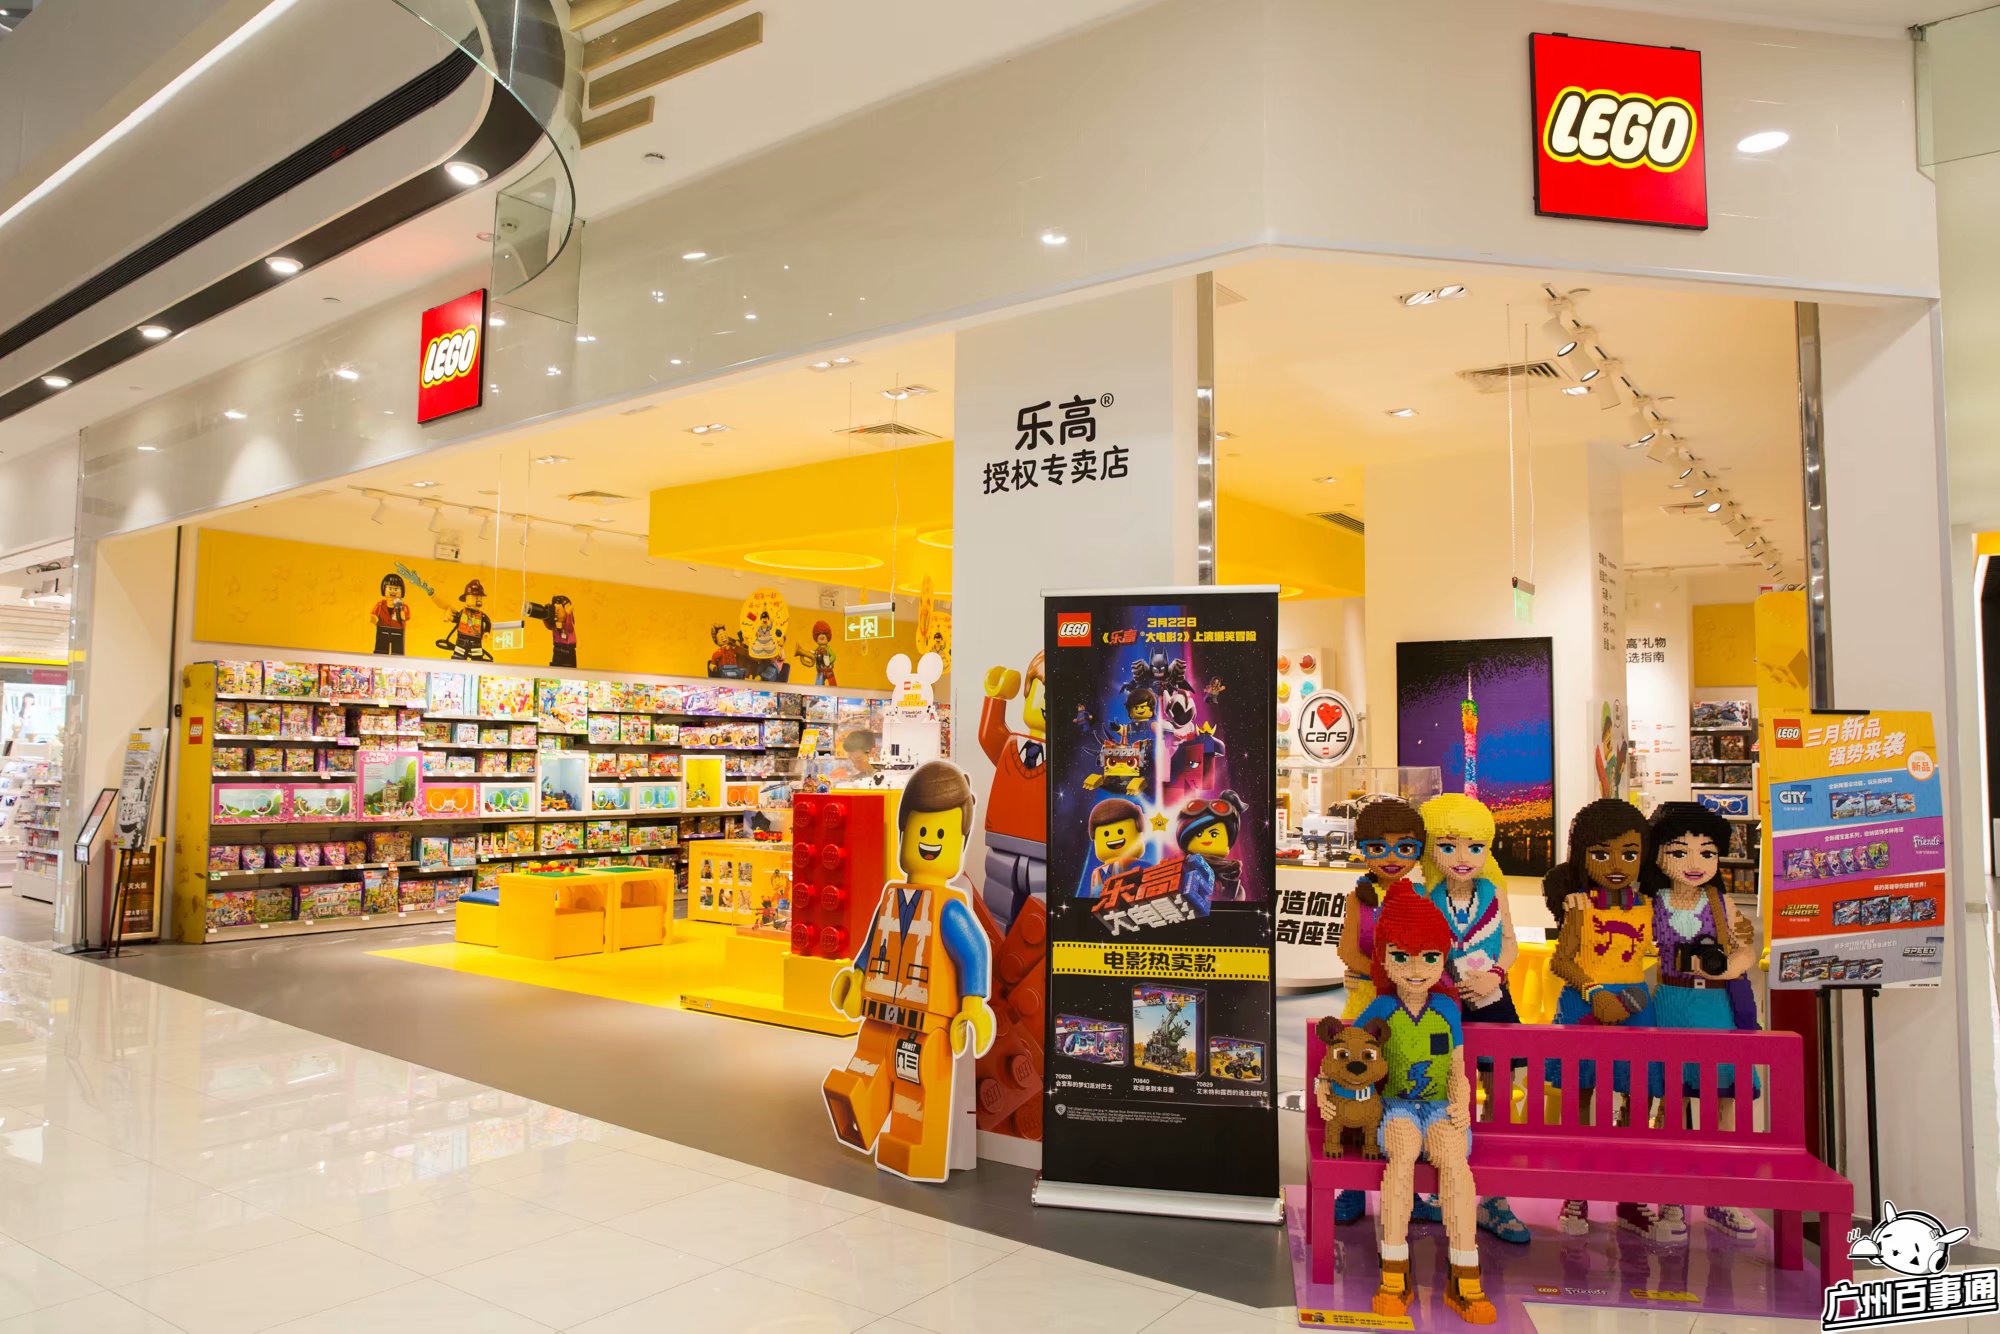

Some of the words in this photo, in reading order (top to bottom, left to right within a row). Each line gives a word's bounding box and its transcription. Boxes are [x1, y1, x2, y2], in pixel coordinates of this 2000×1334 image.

[1550, 92, 1692, 167] LEGO
[423, 328, 477, 385] LEGO
[983, 445, 1129, 494] 授权专卖店
[1059, 622, 1089, 637] LEGO
[1147, 617, 1197, 628] 3月22日
[1625, 651, 1665, 664] 选指南
[1309, 710, 1316, 729] I
[1305, 731, 1347, 743] cars
[1776, 726, 1801, 739] LEGO
[1804, 715, 1881, 748] 三月新品
[1828, 731, 1906, 767] 强势来袭
[1911, 761, 1931, 773] 新品
[1778, 790, 1806, 804] CITY
[1781, 909, 1820, 917] HEROES
[1903, 946, 1936, 955] SPEED
[1103, 951, 1216, 973] 电影热卖款
